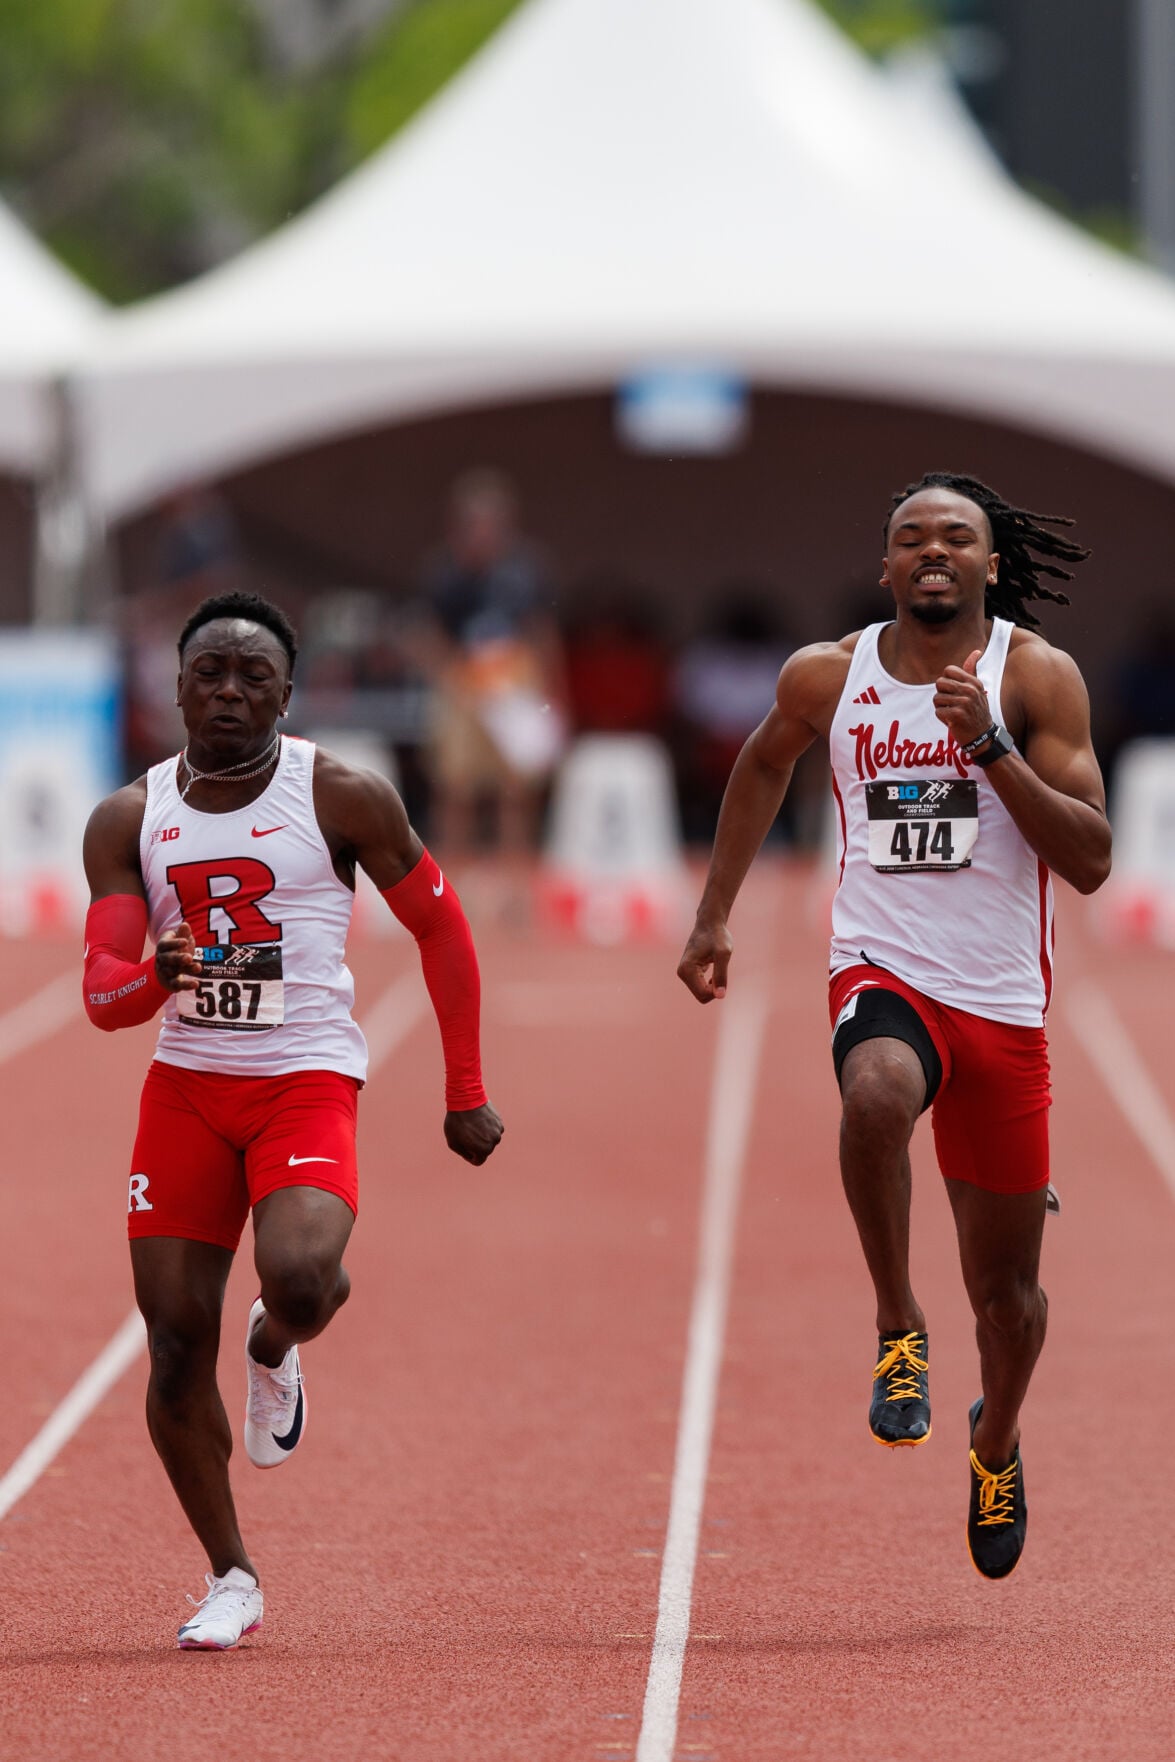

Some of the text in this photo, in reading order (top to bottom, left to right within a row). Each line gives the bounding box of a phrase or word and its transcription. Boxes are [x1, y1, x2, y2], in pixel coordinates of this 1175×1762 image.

[890, 821, 955, 862] 474
[166, 857, 283, 947] R
[89, 974, 147, 1004] SCARLET KNIGHTS
[195, 981, 262, 1020] 587
[128, 1173, 153, 1213] R
